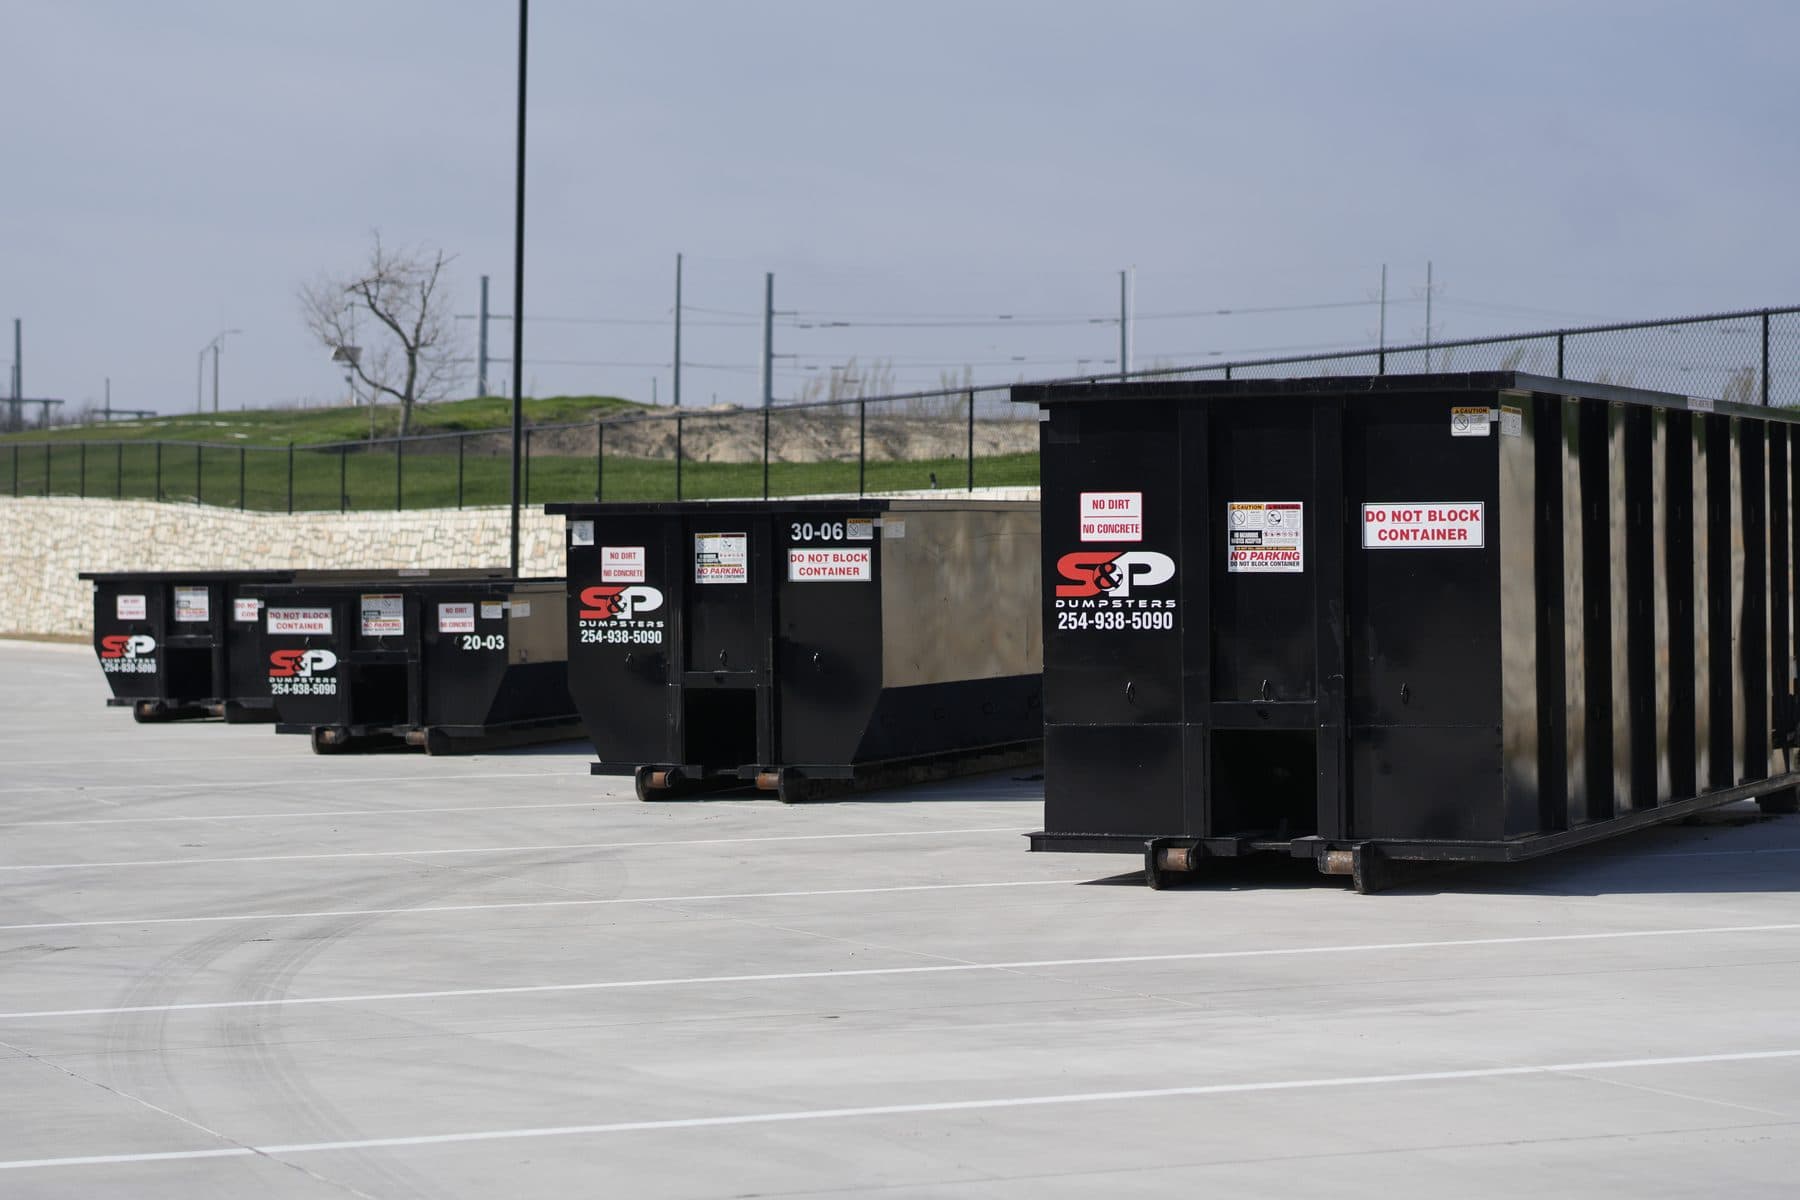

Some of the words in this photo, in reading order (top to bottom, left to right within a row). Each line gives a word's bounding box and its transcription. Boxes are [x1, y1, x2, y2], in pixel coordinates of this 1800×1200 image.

[1092, 499, 1105, 510] NO
[1108, 499, 1130, 510] DIRT
[1365, 511, 1386, 522] DO
[1392, 510, 1423, 522] NOT
[1428, 509, 1480, 521] BLOCK
[791, 522, 843, 540] 30-06
[1083, 524, 1094, 534] NO
[1097, 524, 1140, 533] CONCRETE
[1378, 528, 1468, 541] CONTAINER
[610, 552, 620, 560] NO
[621, 552, 636, 560] DIRT
[790, 553, 804, 562] DO
[808, 553, 829, 562] NOT
[833, 553, 868, 562] BLOCK
[1231, 551, 1247, 560] NO
[1250, 551, 1300, 560] PARKING
[603, 569, 612, 577] NO
[613, 569, 642, 577] CONCRETE
[799, 567, 860, 576] CONTAINER
[1056, 551, 1176, 597] S&P
[580, 586, 663, 619] S&P
[1056, 600, 1176, 608] DUMPSTERS
[276, 622, 324, 630] CONTAINER
[579, 620, 664, 628] DUMPSTERS
[1058, 611, 1173, 630] 254-938-5090
[463, 635, 505, 650] 20-03
[581, 629, 662, 644] 254-938-5090
[101, 634, 156, 658] S&P
[269, 649, 337, 677] S&P
[271, 683, 337, 695] 254-938-5090
